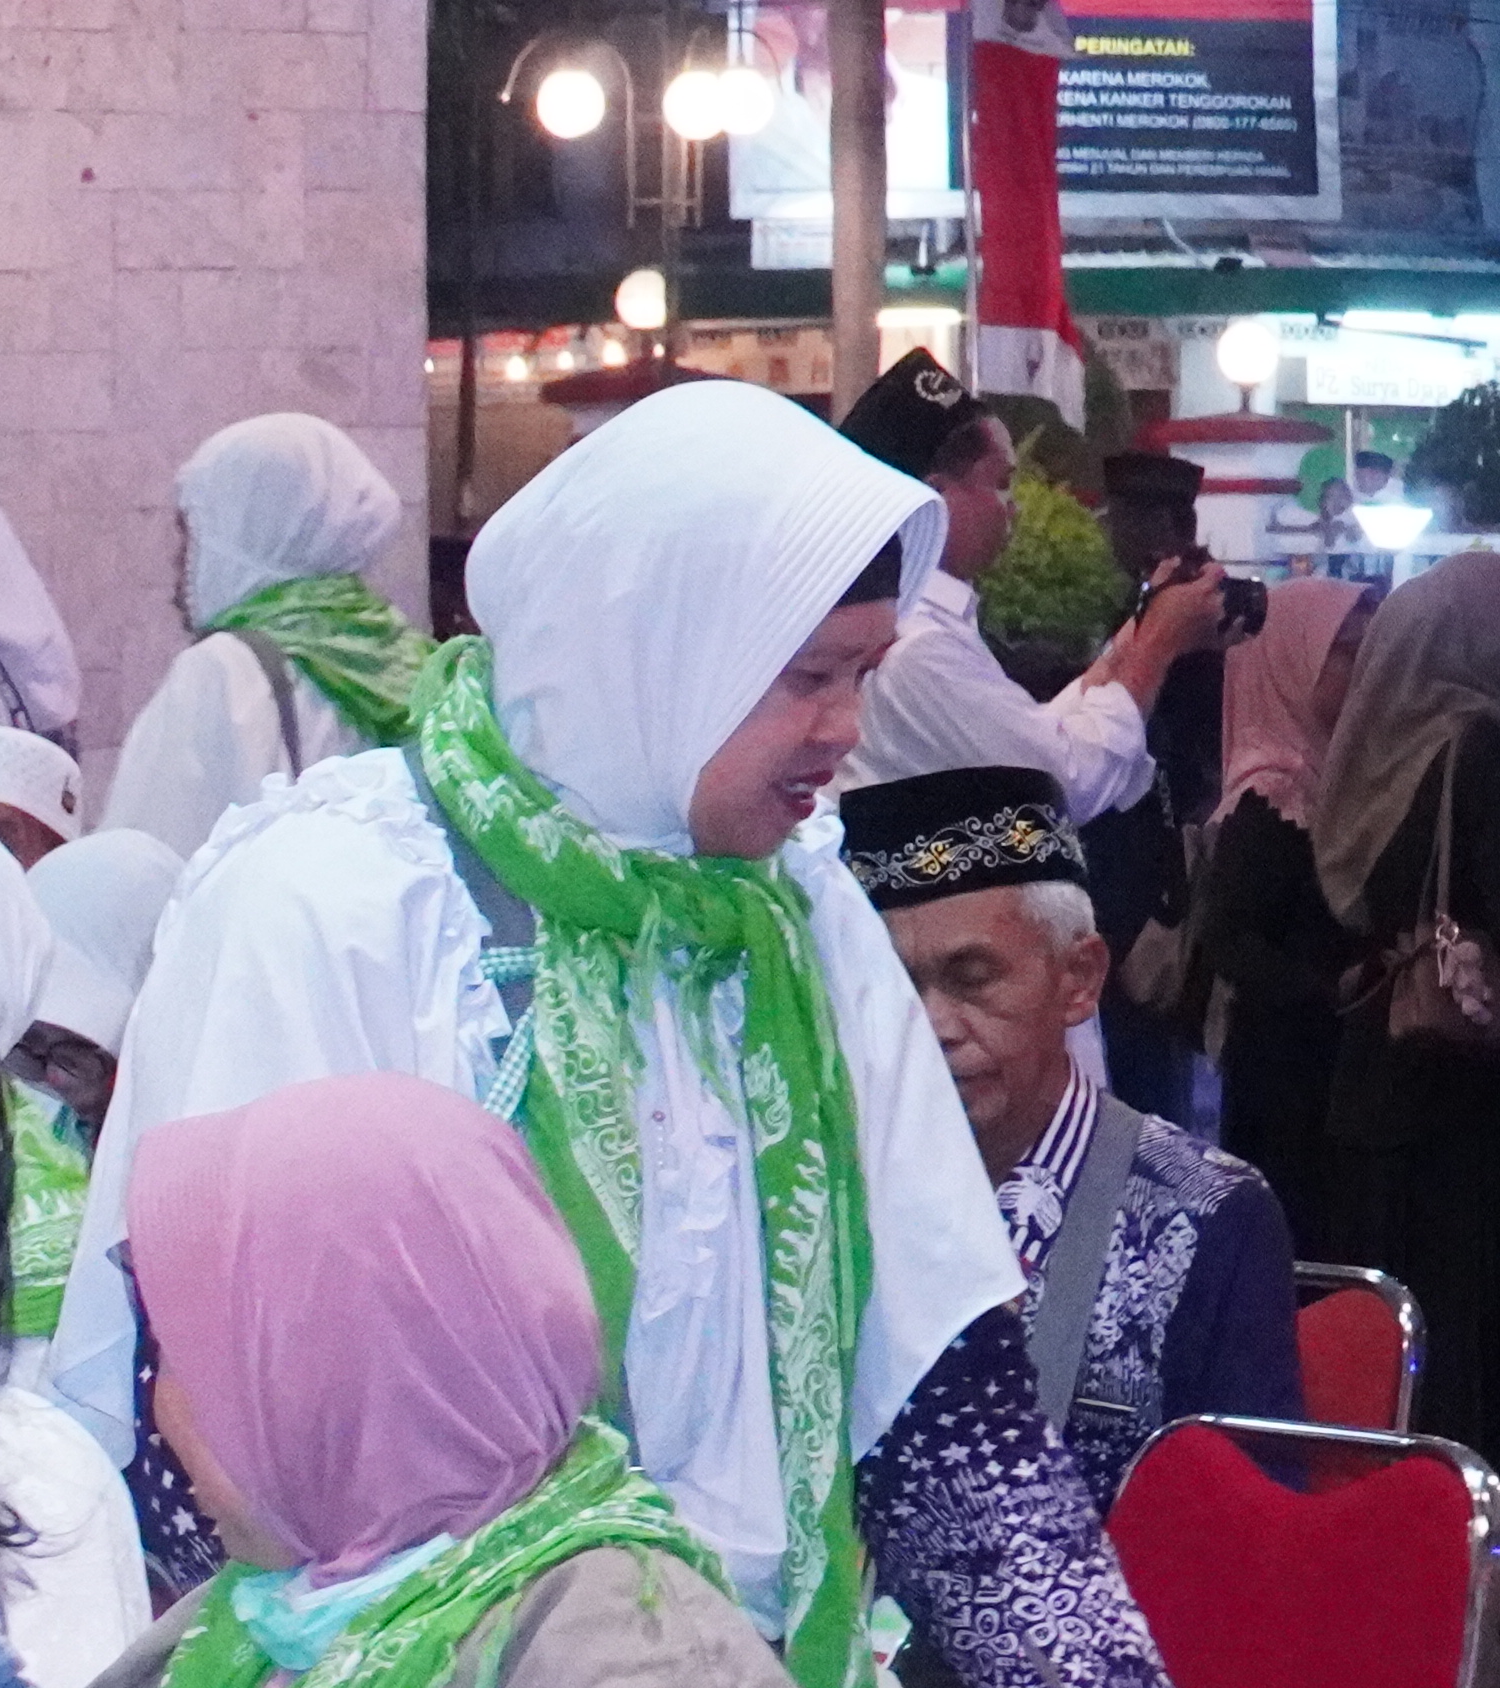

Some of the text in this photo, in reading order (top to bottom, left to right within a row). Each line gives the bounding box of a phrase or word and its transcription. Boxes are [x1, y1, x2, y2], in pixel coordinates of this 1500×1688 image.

[1075, 36, 1196, 56] PERINGATAN:
[1058, 70, 1125, 87] KARENA
[1100, 92, 1165, 108] KANKER
[1169, 94, 1293, 110] TENGGOROKAN
